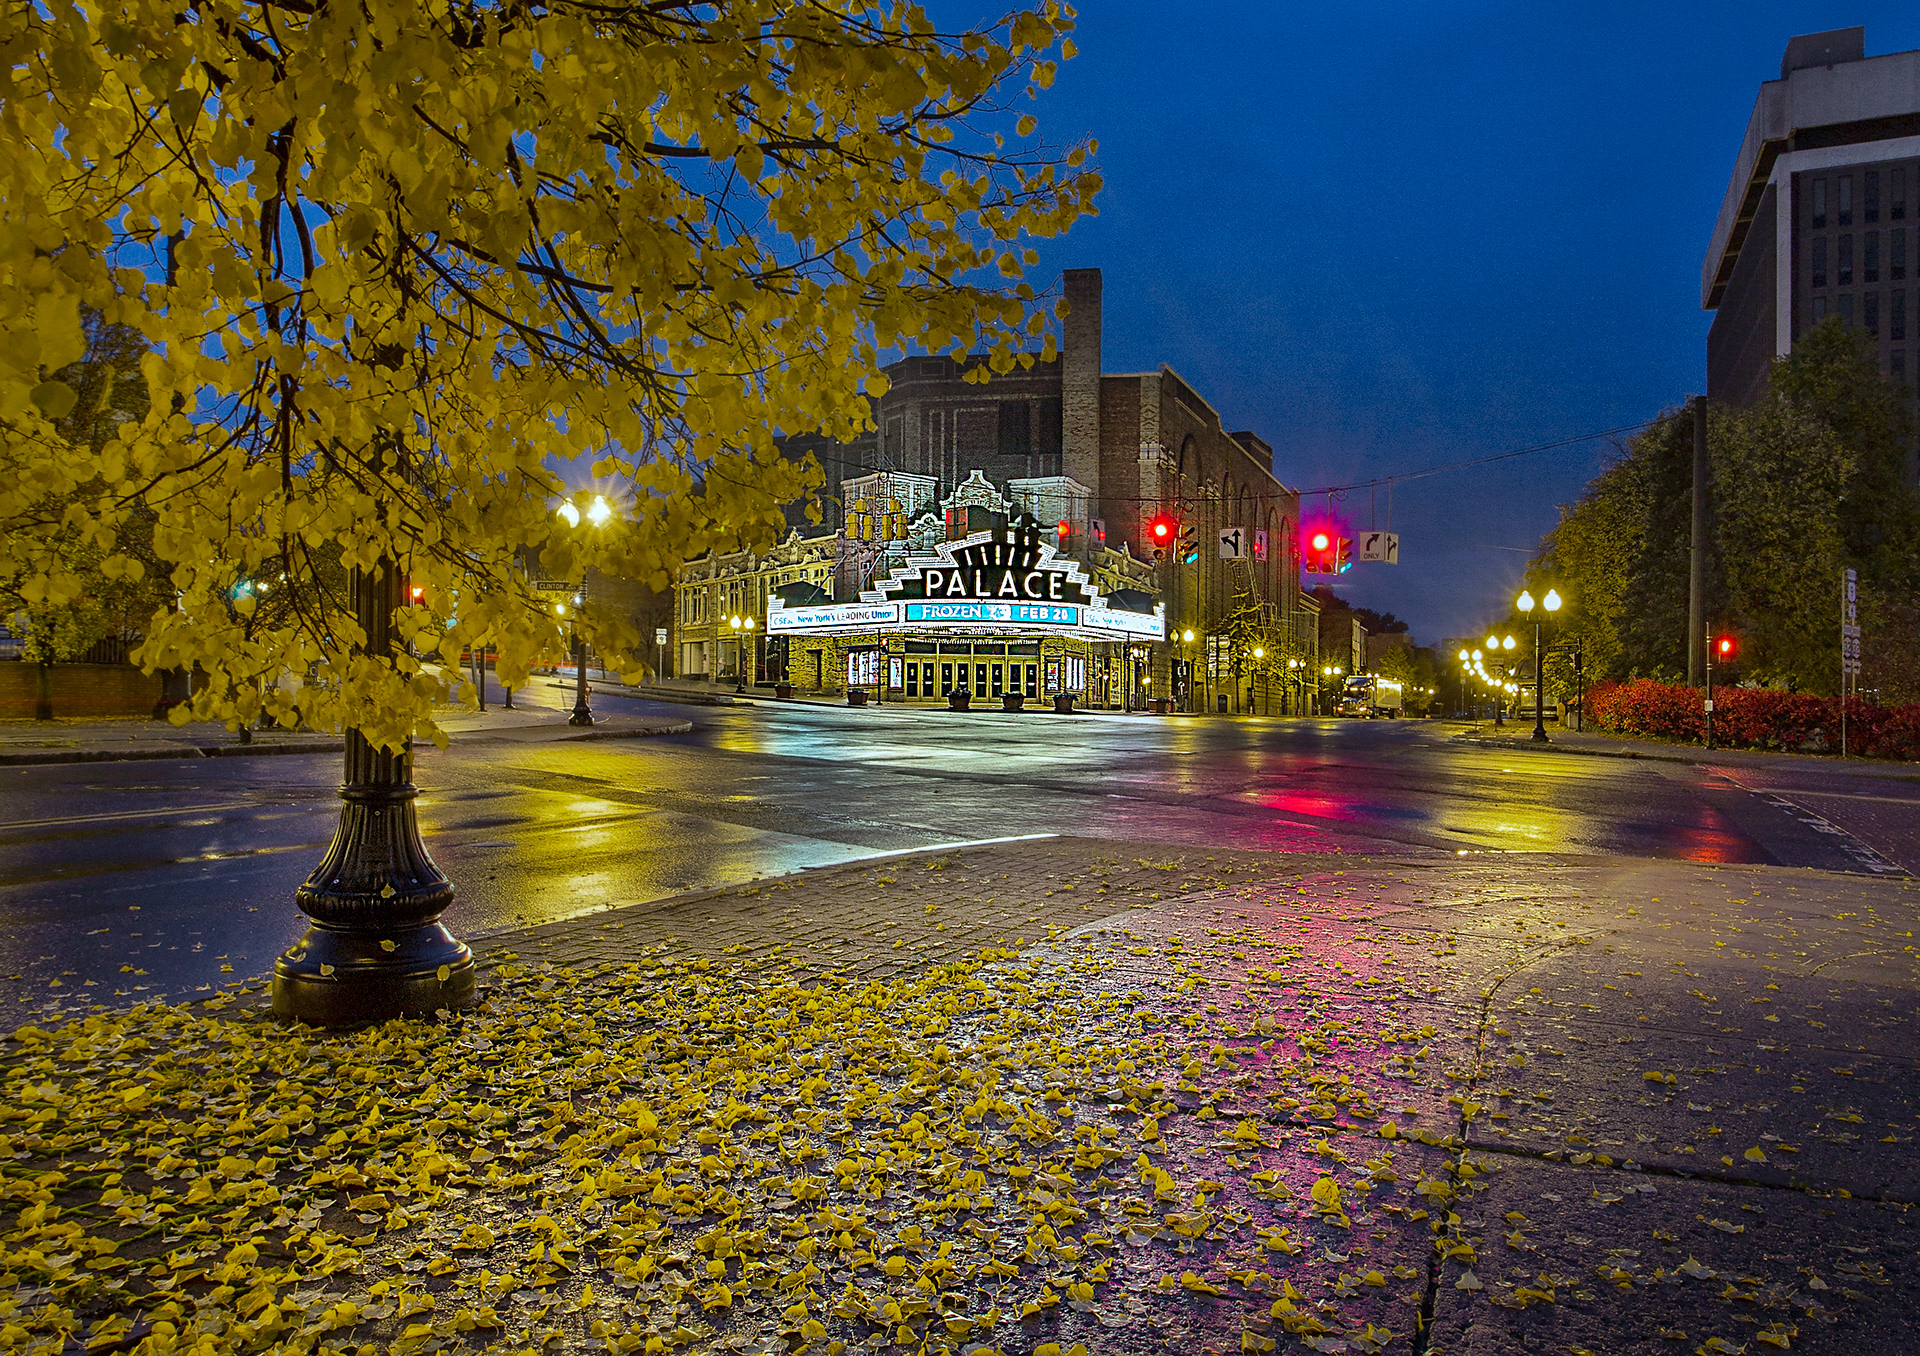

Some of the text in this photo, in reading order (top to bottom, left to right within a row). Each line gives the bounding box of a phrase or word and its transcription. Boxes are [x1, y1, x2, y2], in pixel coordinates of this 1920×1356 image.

[926, 569, 1063, 600] PALACE
[797, 615, 813, 623] New
[815, 612, 835, 622] York's
[837, 611, 870, 621] LEADING
[871, 610, 895, 619] Union
[921, 604, 982, 620] FROZEN
[1019, 606, 1049, 620] FEB
[1490, 668, 1502, 676] 32
